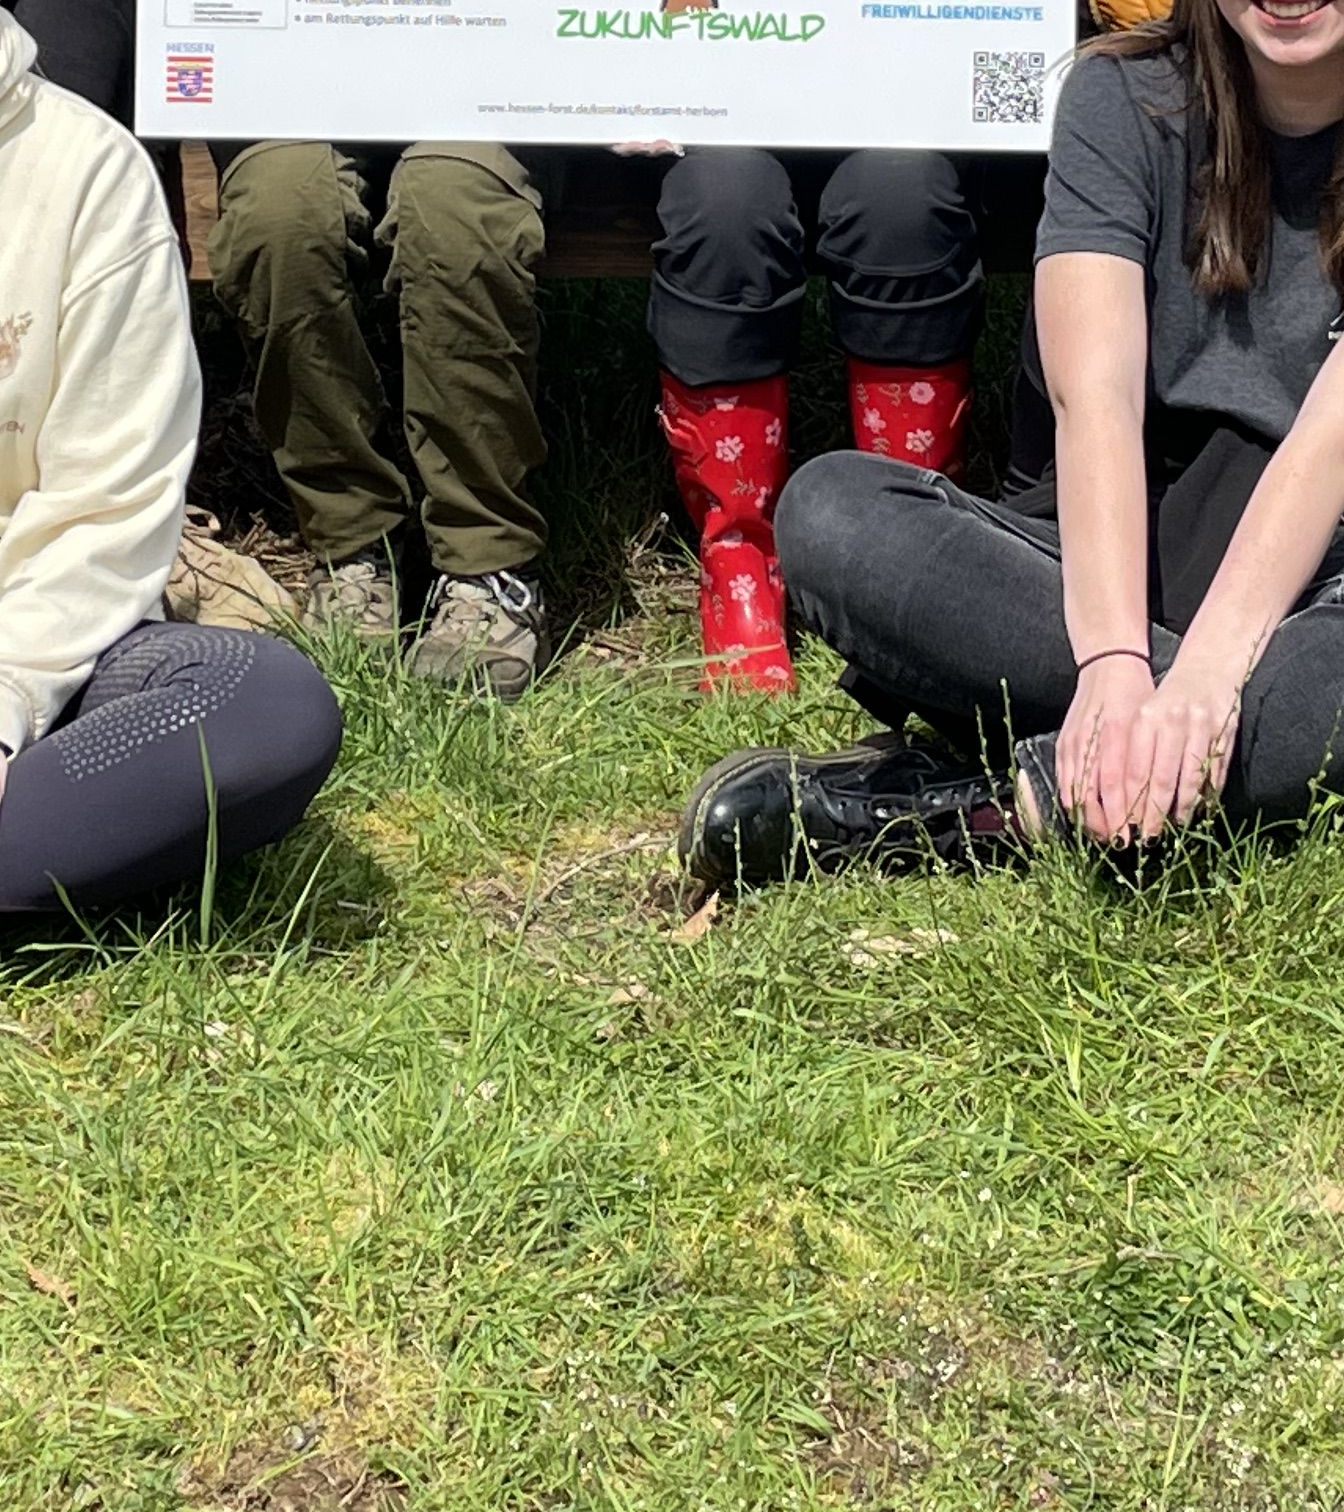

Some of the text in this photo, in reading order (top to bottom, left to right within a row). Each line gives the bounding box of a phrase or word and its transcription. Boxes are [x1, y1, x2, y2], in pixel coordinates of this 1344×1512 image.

[304, 15, 323, 24] am
[326, 14, 410, 26] Rettungspunkt
[413, 15, 433, 25] auf
[465, 16, 506, 26] warten
[861, 5, 1044, 21] FREIWILLIGENDIENSTE
[556, 8, 826, 41] ZUKUNFTSWALD
[166, 43, 215, 53] HESSEN
